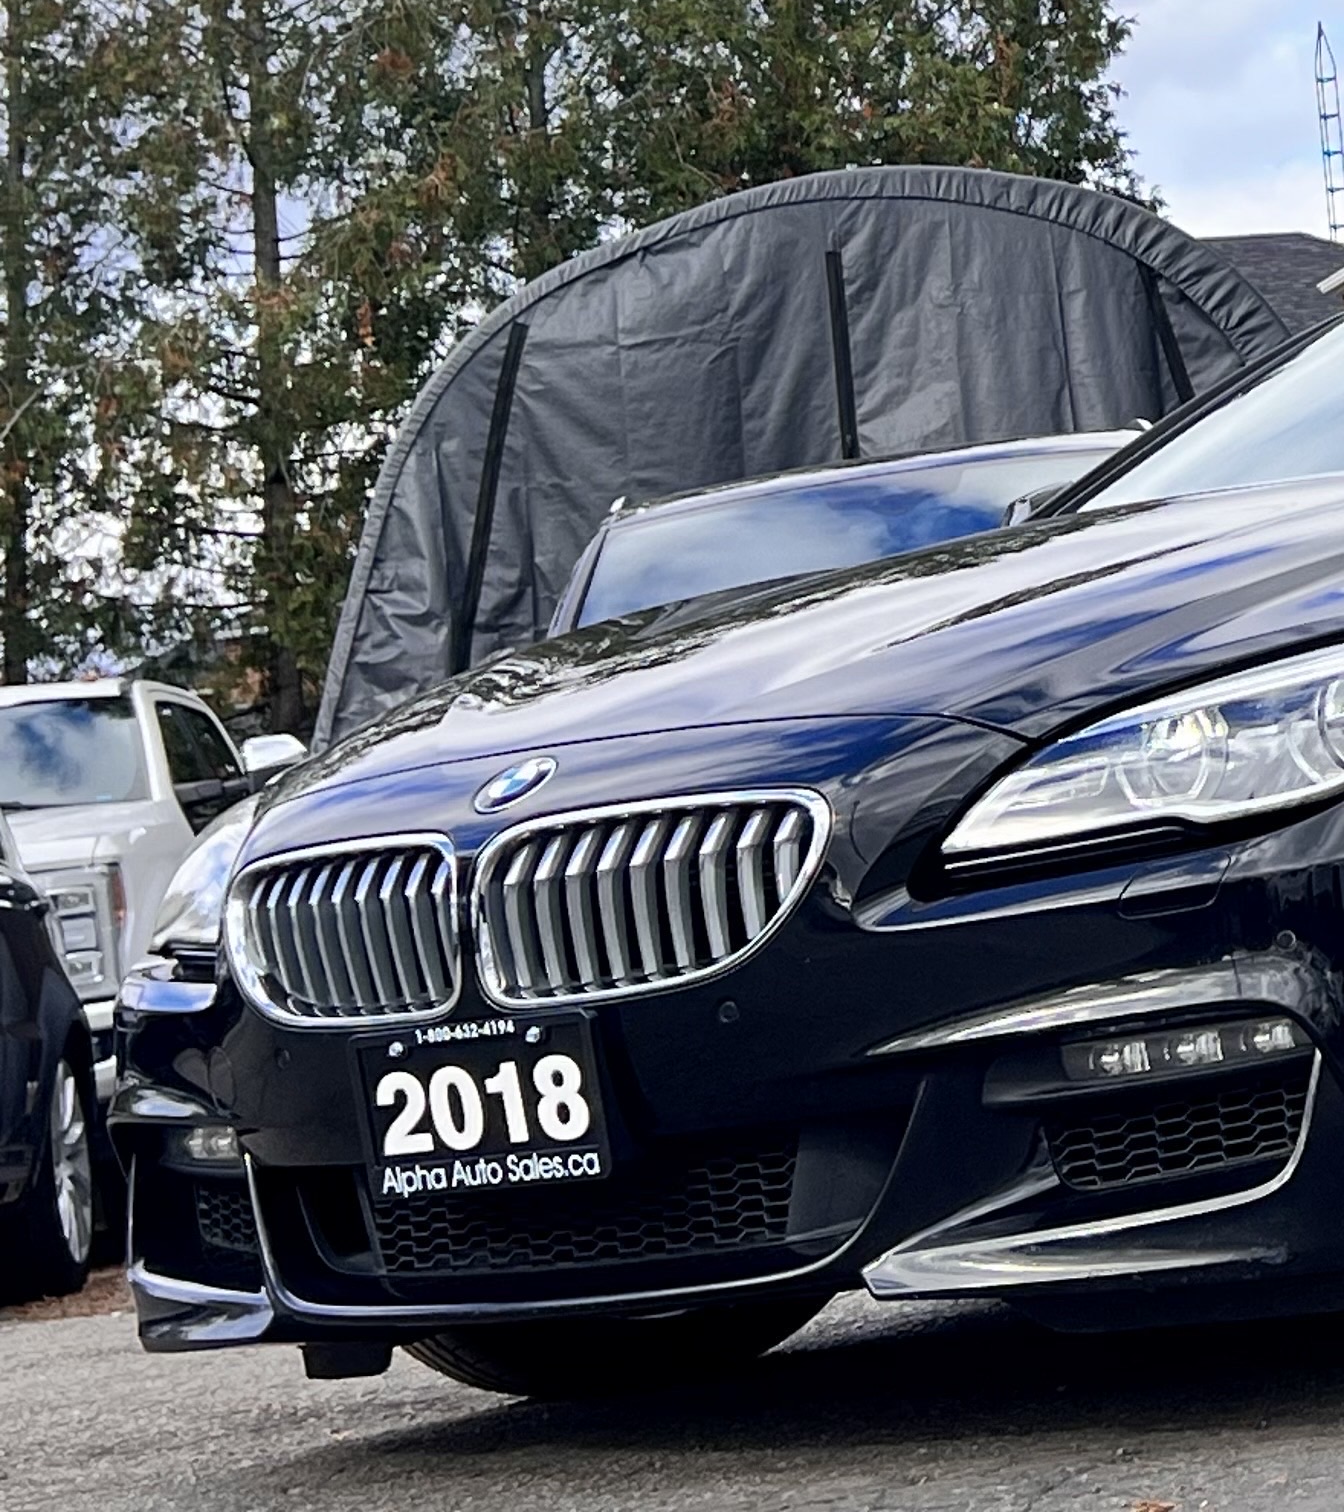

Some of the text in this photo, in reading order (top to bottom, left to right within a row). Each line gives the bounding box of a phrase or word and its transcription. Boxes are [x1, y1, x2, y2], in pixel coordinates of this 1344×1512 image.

[376, 1054, 590, 1157] 2018
[382, 1152, 601, 1198] Alpha Auto Sales.ca
